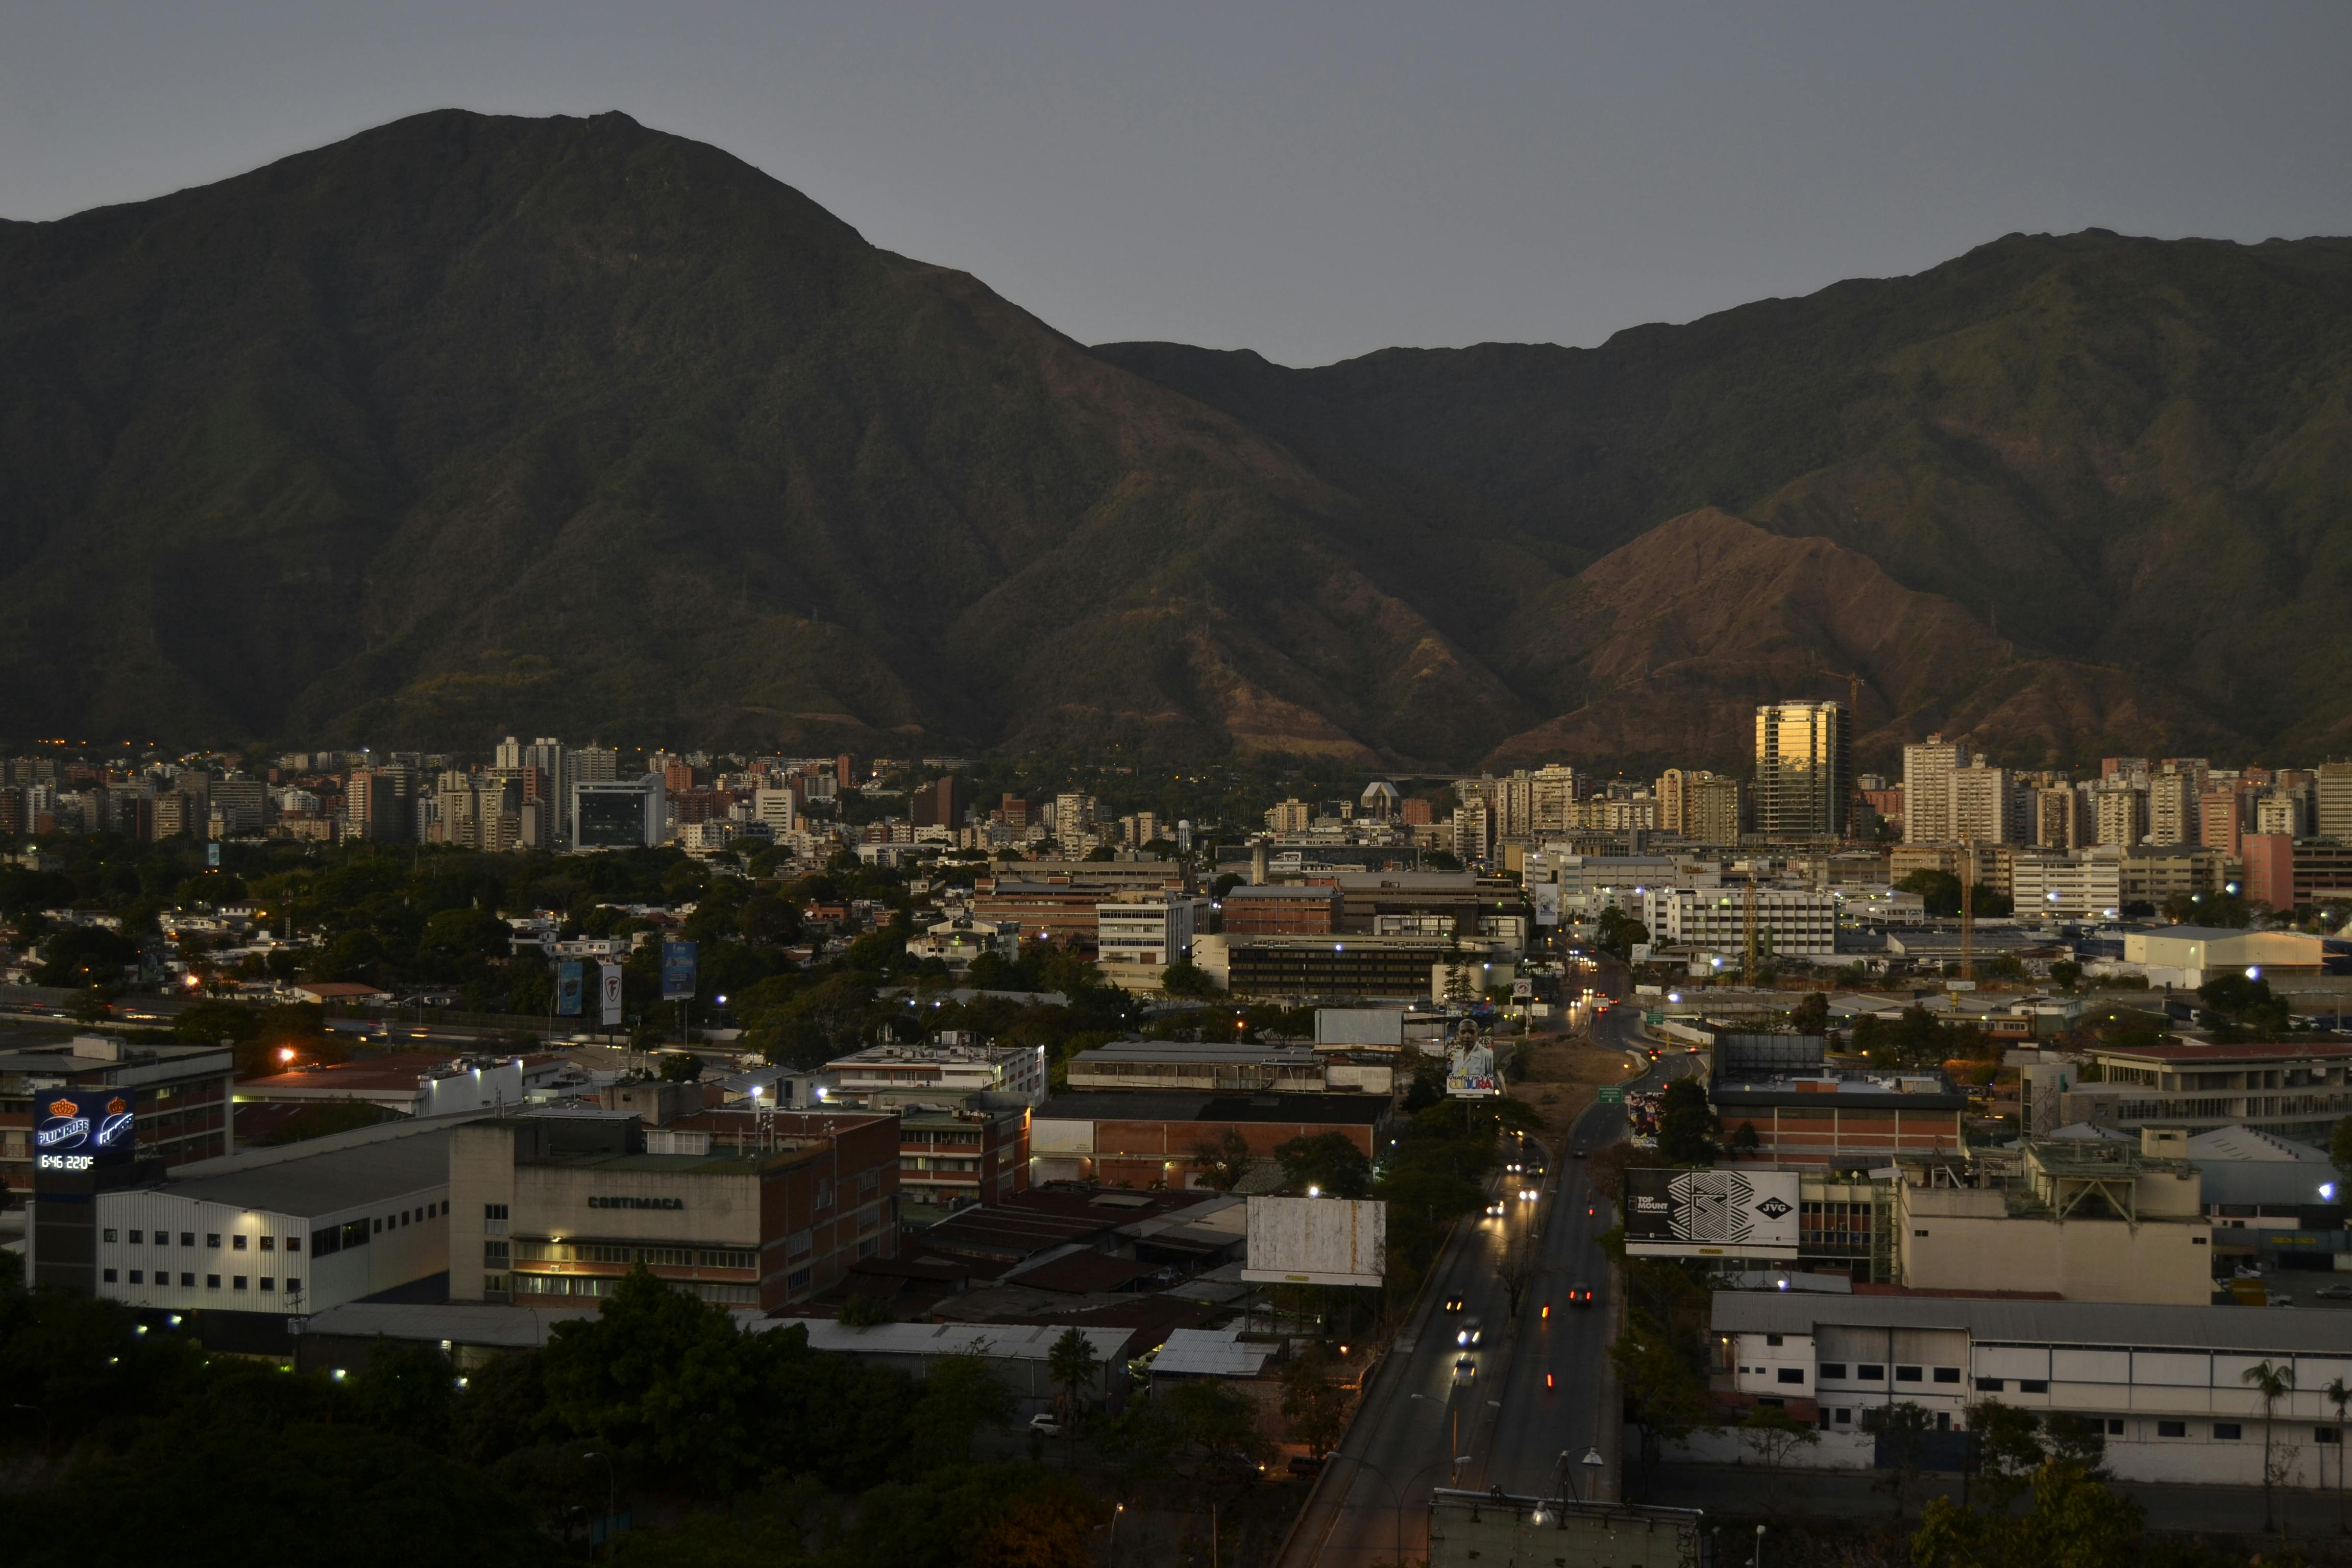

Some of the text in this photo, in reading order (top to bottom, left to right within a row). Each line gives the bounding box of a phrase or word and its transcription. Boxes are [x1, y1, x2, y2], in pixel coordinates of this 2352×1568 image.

[38, 1119, 90, 1144] PLUMROSE
[42, 1155, 63, 1168] 6:46
[588, 1197, 683, 1210] CONTIMACA
[1762, 1204, 1786, 1212] JVG
